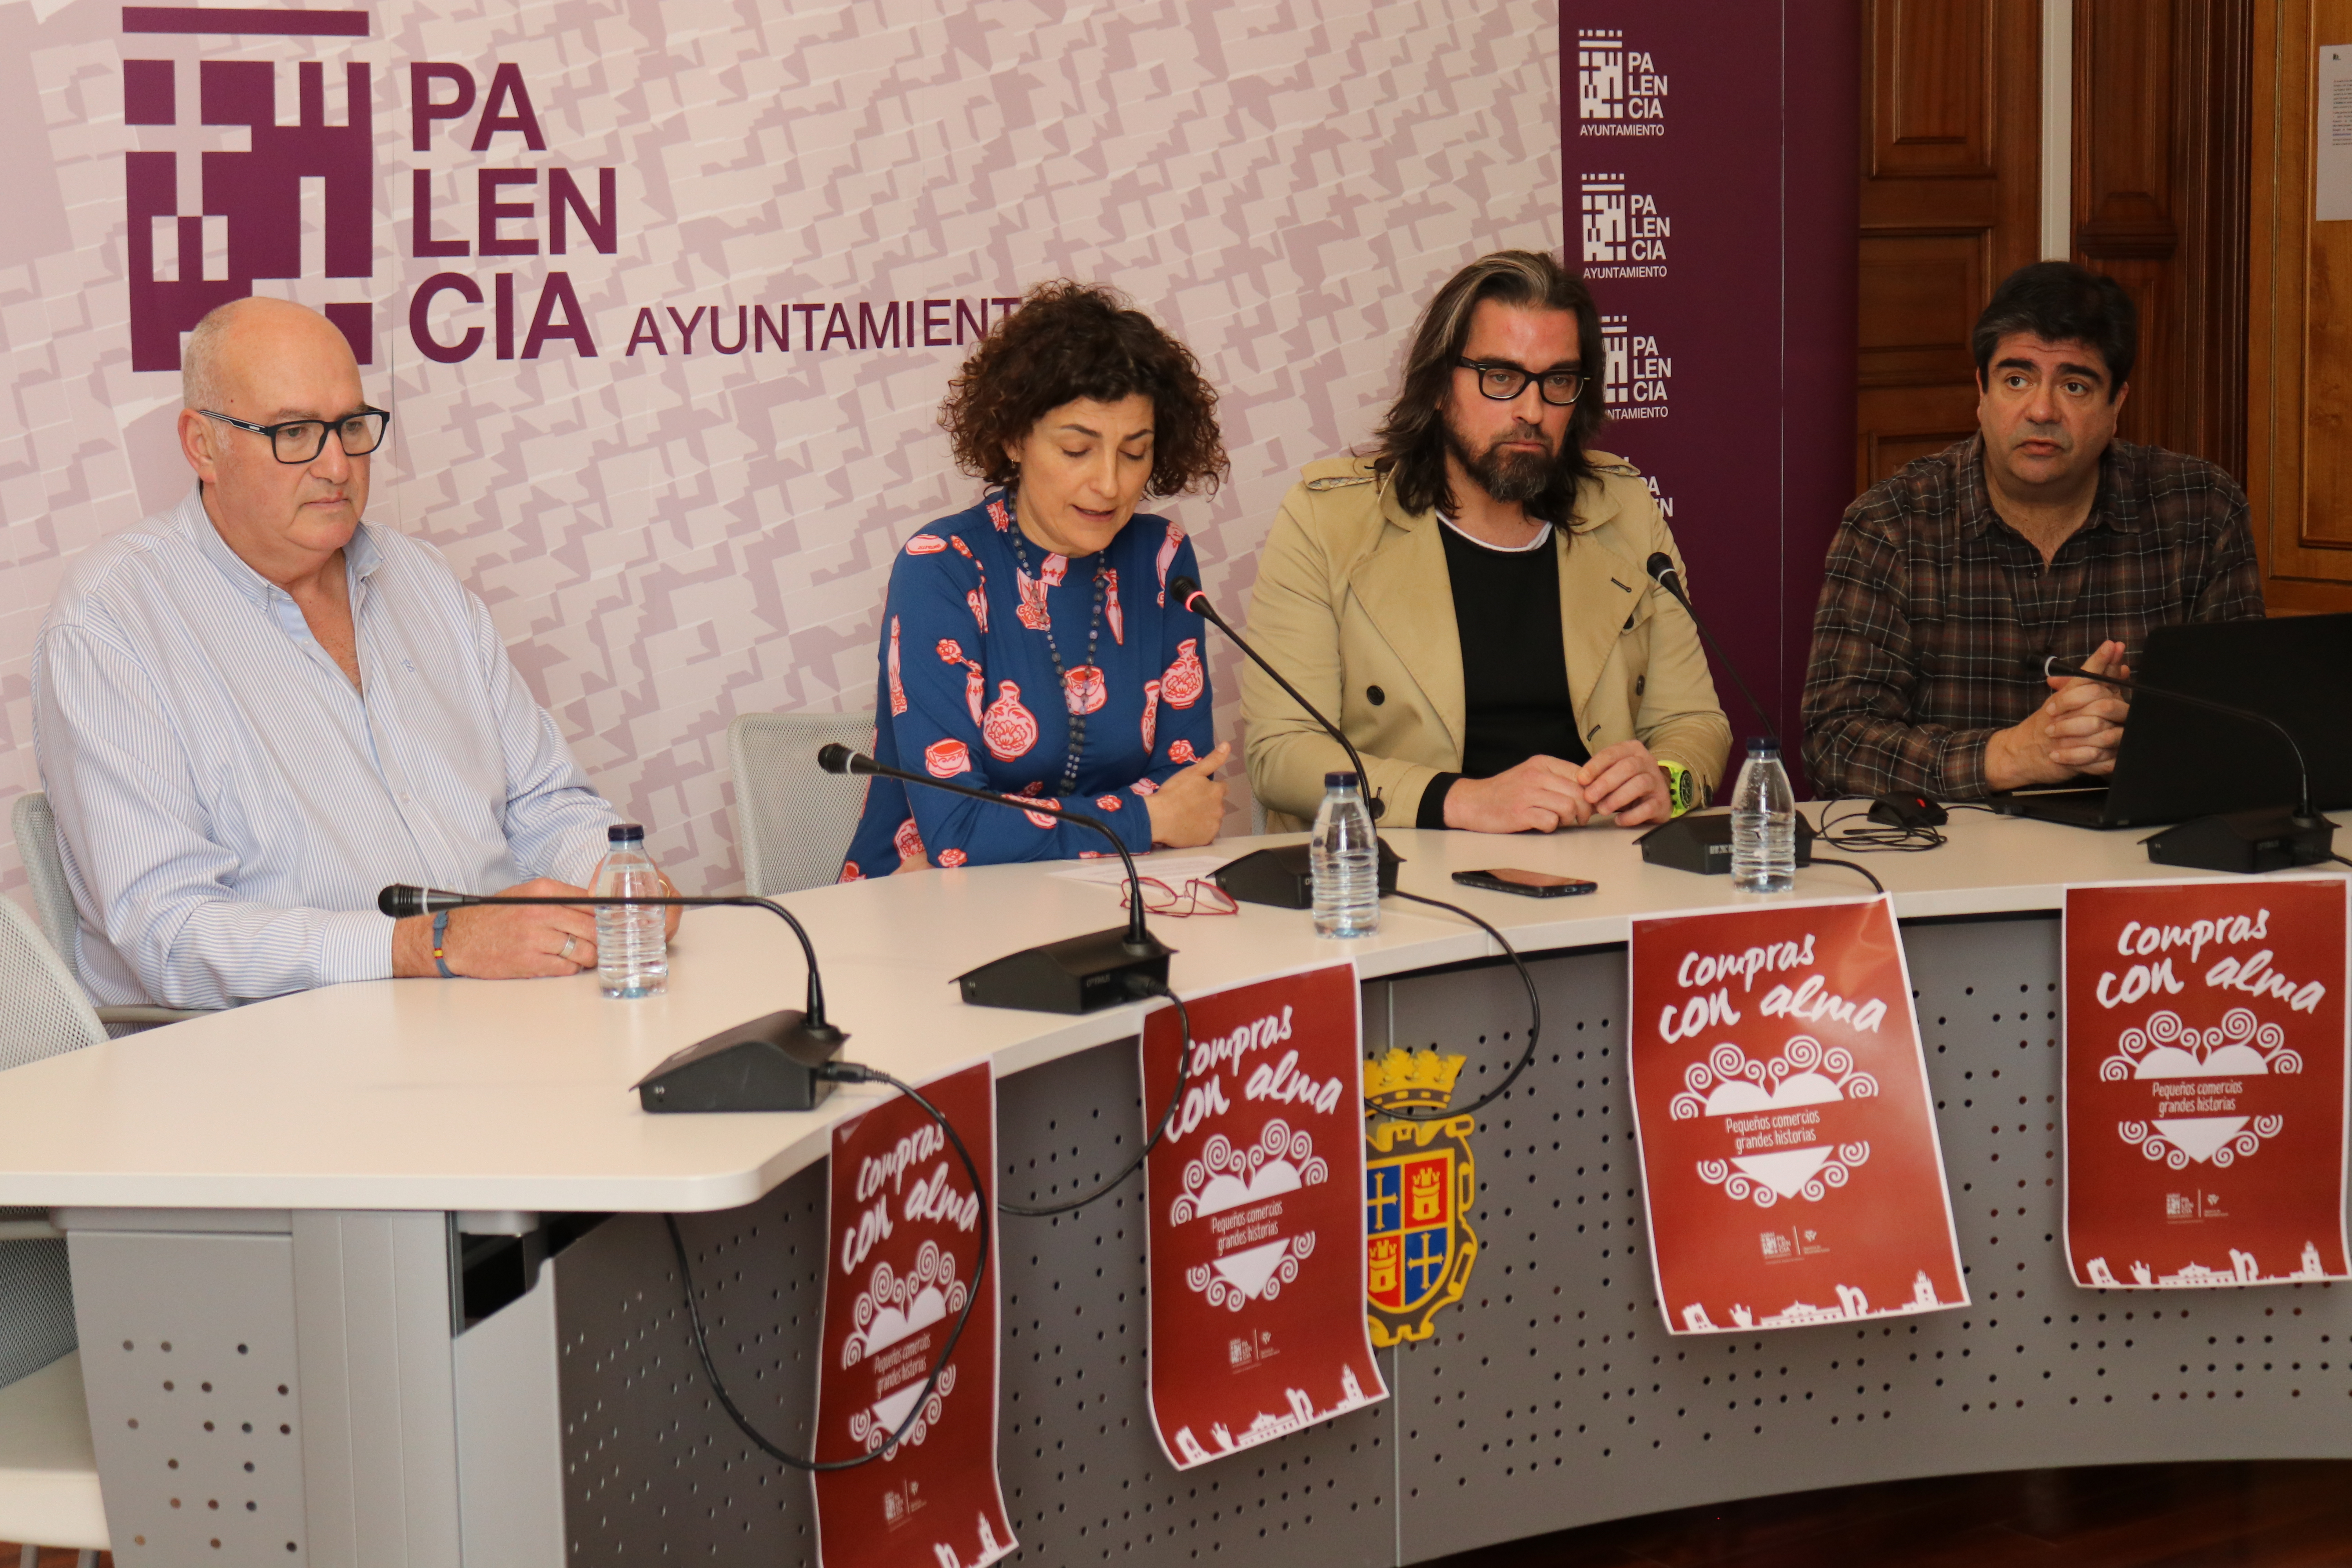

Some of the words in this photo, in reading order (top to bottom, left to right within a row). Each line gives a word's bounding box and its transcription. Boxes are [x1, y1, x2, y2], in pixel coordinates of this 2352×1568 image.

[1629, 52, 1655, 73] PA
[1629, 75, 1668, 96] LEN
[410, 62, 548, 152] PA
[1628, 97, 1664, 119] CIA
[1580, 124, 1665, 136] AYUNTAMIENTO
[412, 167, 618, 258] LEN
[1631, 194, 1657, 215] PA
[1632, 217, 1670, 238] LEN
[1631, 239, 1667, 261] CIA
[1583, 265, 1668, 279] AYUNTAMIENTO
[409, 271, 599, 363] CIA
[626, 297, 1023, 356] AYUNTAMIENT
[1633, 336, 1659, 356] PA
[1633, 357, 1672, 379] LEN
[1633, 381, 1668, 401] CIA
[2096, 956, 2185, 1009] con
[2205, 949, 2326, 1014] alma
[1659, 987, 1741, 1044] con
[1759, 975, 1887, 1033] alma
[1245, 1049, 1343, 1114] alma
[2152, 1081, 2196, 1100] Pequeños
[2197, 1079, 2243, 1094] comercios
[2158, 1097, 2196, 1118] grandes
[2196, 1096, 2236, 1112] historias
[1726, 1115, 1771, 1136] Pequeños
[1772, 1109, 1821, 1128] comercios
[1735, 1132, 1774, 1155] grandes
[1775, 1127, 1817, 1145] historias
[842, 1193, 894, 1275] con
[904, 1161, 980, 1232] alma
[1212, 1210, 1246, 1235] Pequeños
[1247, 1200, 1283, 1223] comercios
[1218, 1228, 1247, 1257] grandes
[1248, 1221, 1279, 1242] historias
